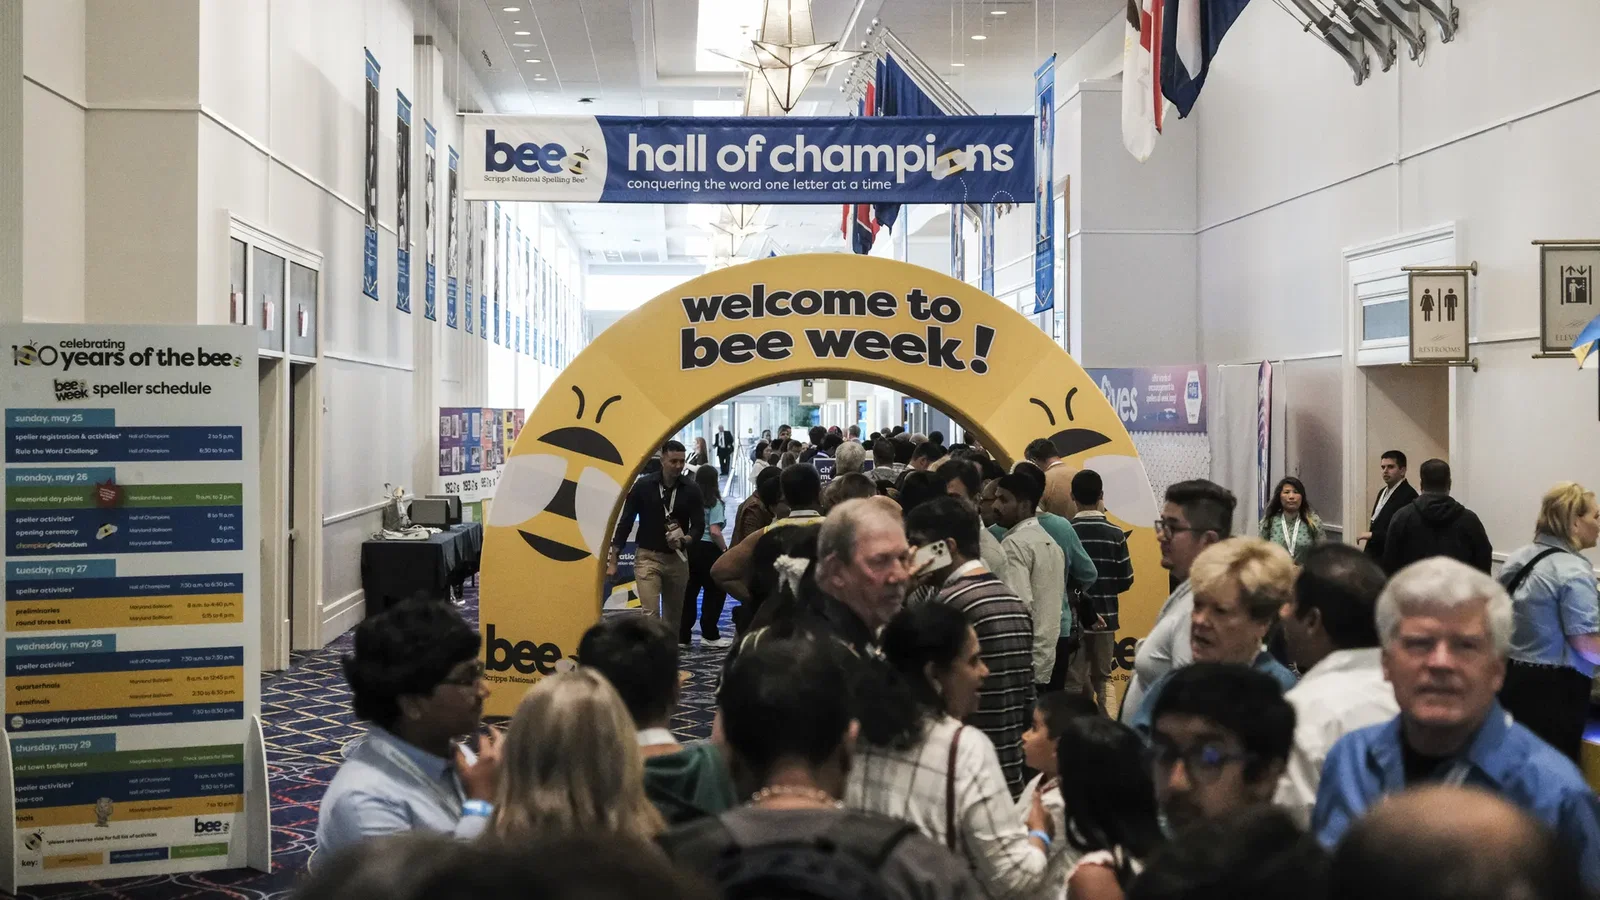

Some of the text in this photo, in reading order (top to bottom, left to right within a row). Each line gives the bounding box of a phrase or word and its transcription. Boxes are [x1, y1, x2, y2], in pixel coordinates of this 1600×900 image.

[485, 129, 567, 173] bee
[628, 133, 766, 173] hall of
[484, 175, 510, 183] Scripps
[542, 176, 570, 184] Spelling
[627, 179, 891, 192] conquering the word one letter at a time
[681, 283, 962, 324] welcome to
[59, 338, 125, 351] celebrating
[680, 323, 995, 375] bee week!
[60, 351, 125, 371] years
[129, 347, 154, 366] of
[156, 347, 194, 366] the
[198, 347, 232, 366] bee
[54, 379, 78, 392] bee
[56, 381, 212, 401] week speller schedule
[15, 414, 83, 424] sunday, may 25
[16, 474, 54, 482] monday,
[16, 566, 54, 575] tuesday,
[16, 641, 69, 651] wednesday,
[70, 642, 89, 650] may
[485, 623, 563, 676] bee
[509, 676, 536, 684] National
[25, 716, 70, 724] lexicography
[70, 714, 118, 723] presentations
[15, 743, 57, 752] thursday,
[59, 743, 78, 751] may
[194, 818, 222, 833] bee
